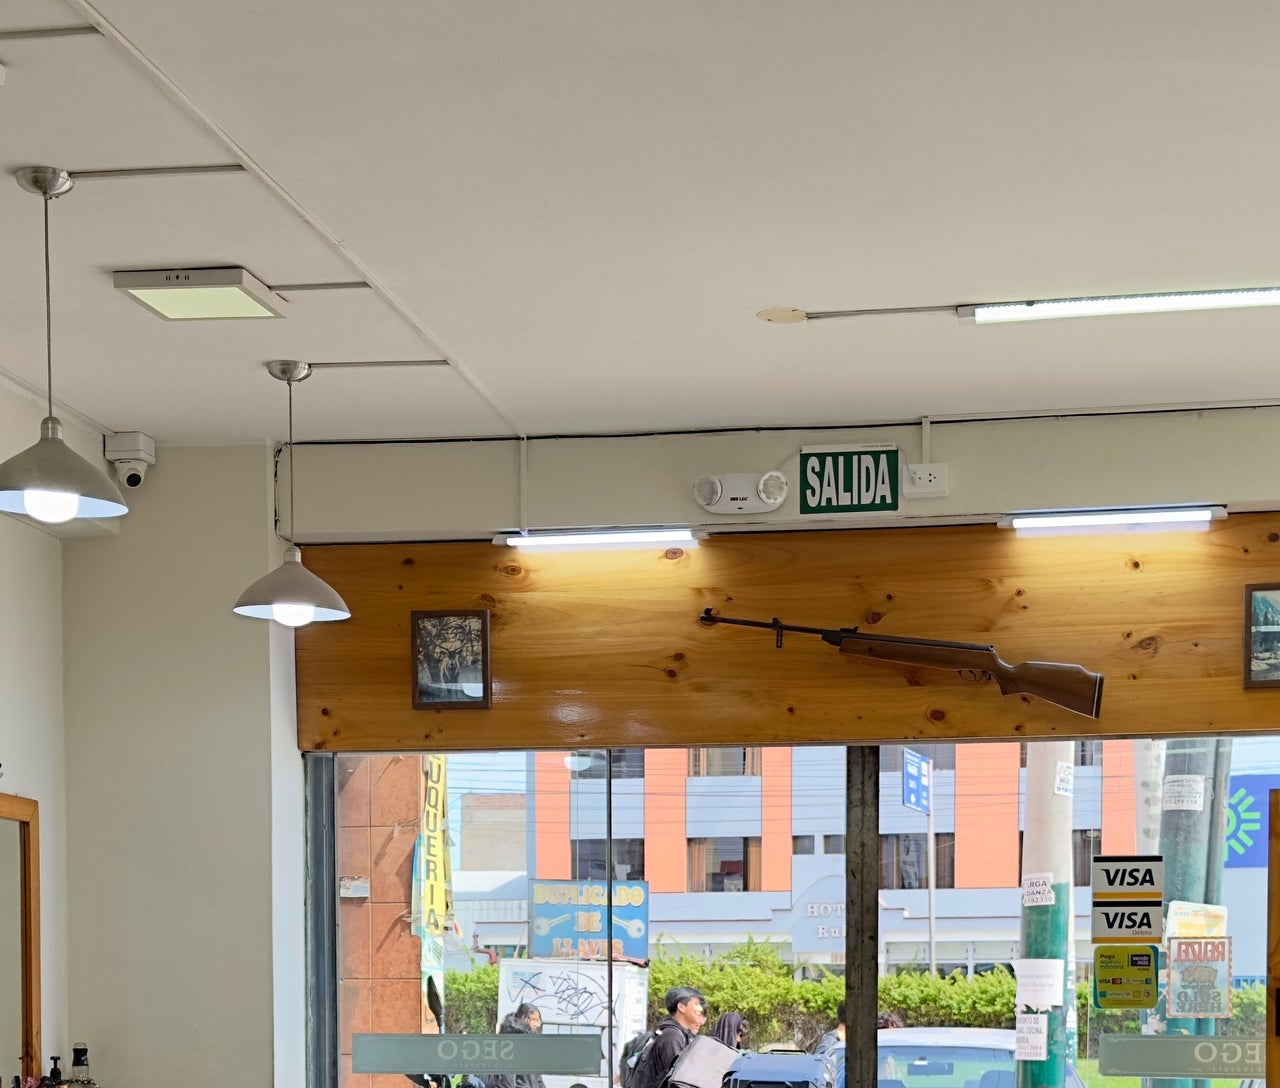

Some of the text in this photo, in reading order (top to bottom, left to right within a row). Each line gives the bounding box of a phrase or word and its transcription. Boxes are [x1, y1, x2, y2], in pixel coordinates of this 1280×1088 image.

[806, 453, 892, 508] SALIDA
[424, 752, 443, 930] UQUERIA
[1024, 880, 1047, 888] RGA
[1101, 868, 1155, 887] VISA
[533, 883, 645, 907] DUPLICADO
[806, 903, 846, 918] HOT
[1100, 911, 1153, 929] VISA
[575, 911, 602, 933] DE
[552, 938, 625, 958] LLAVES
